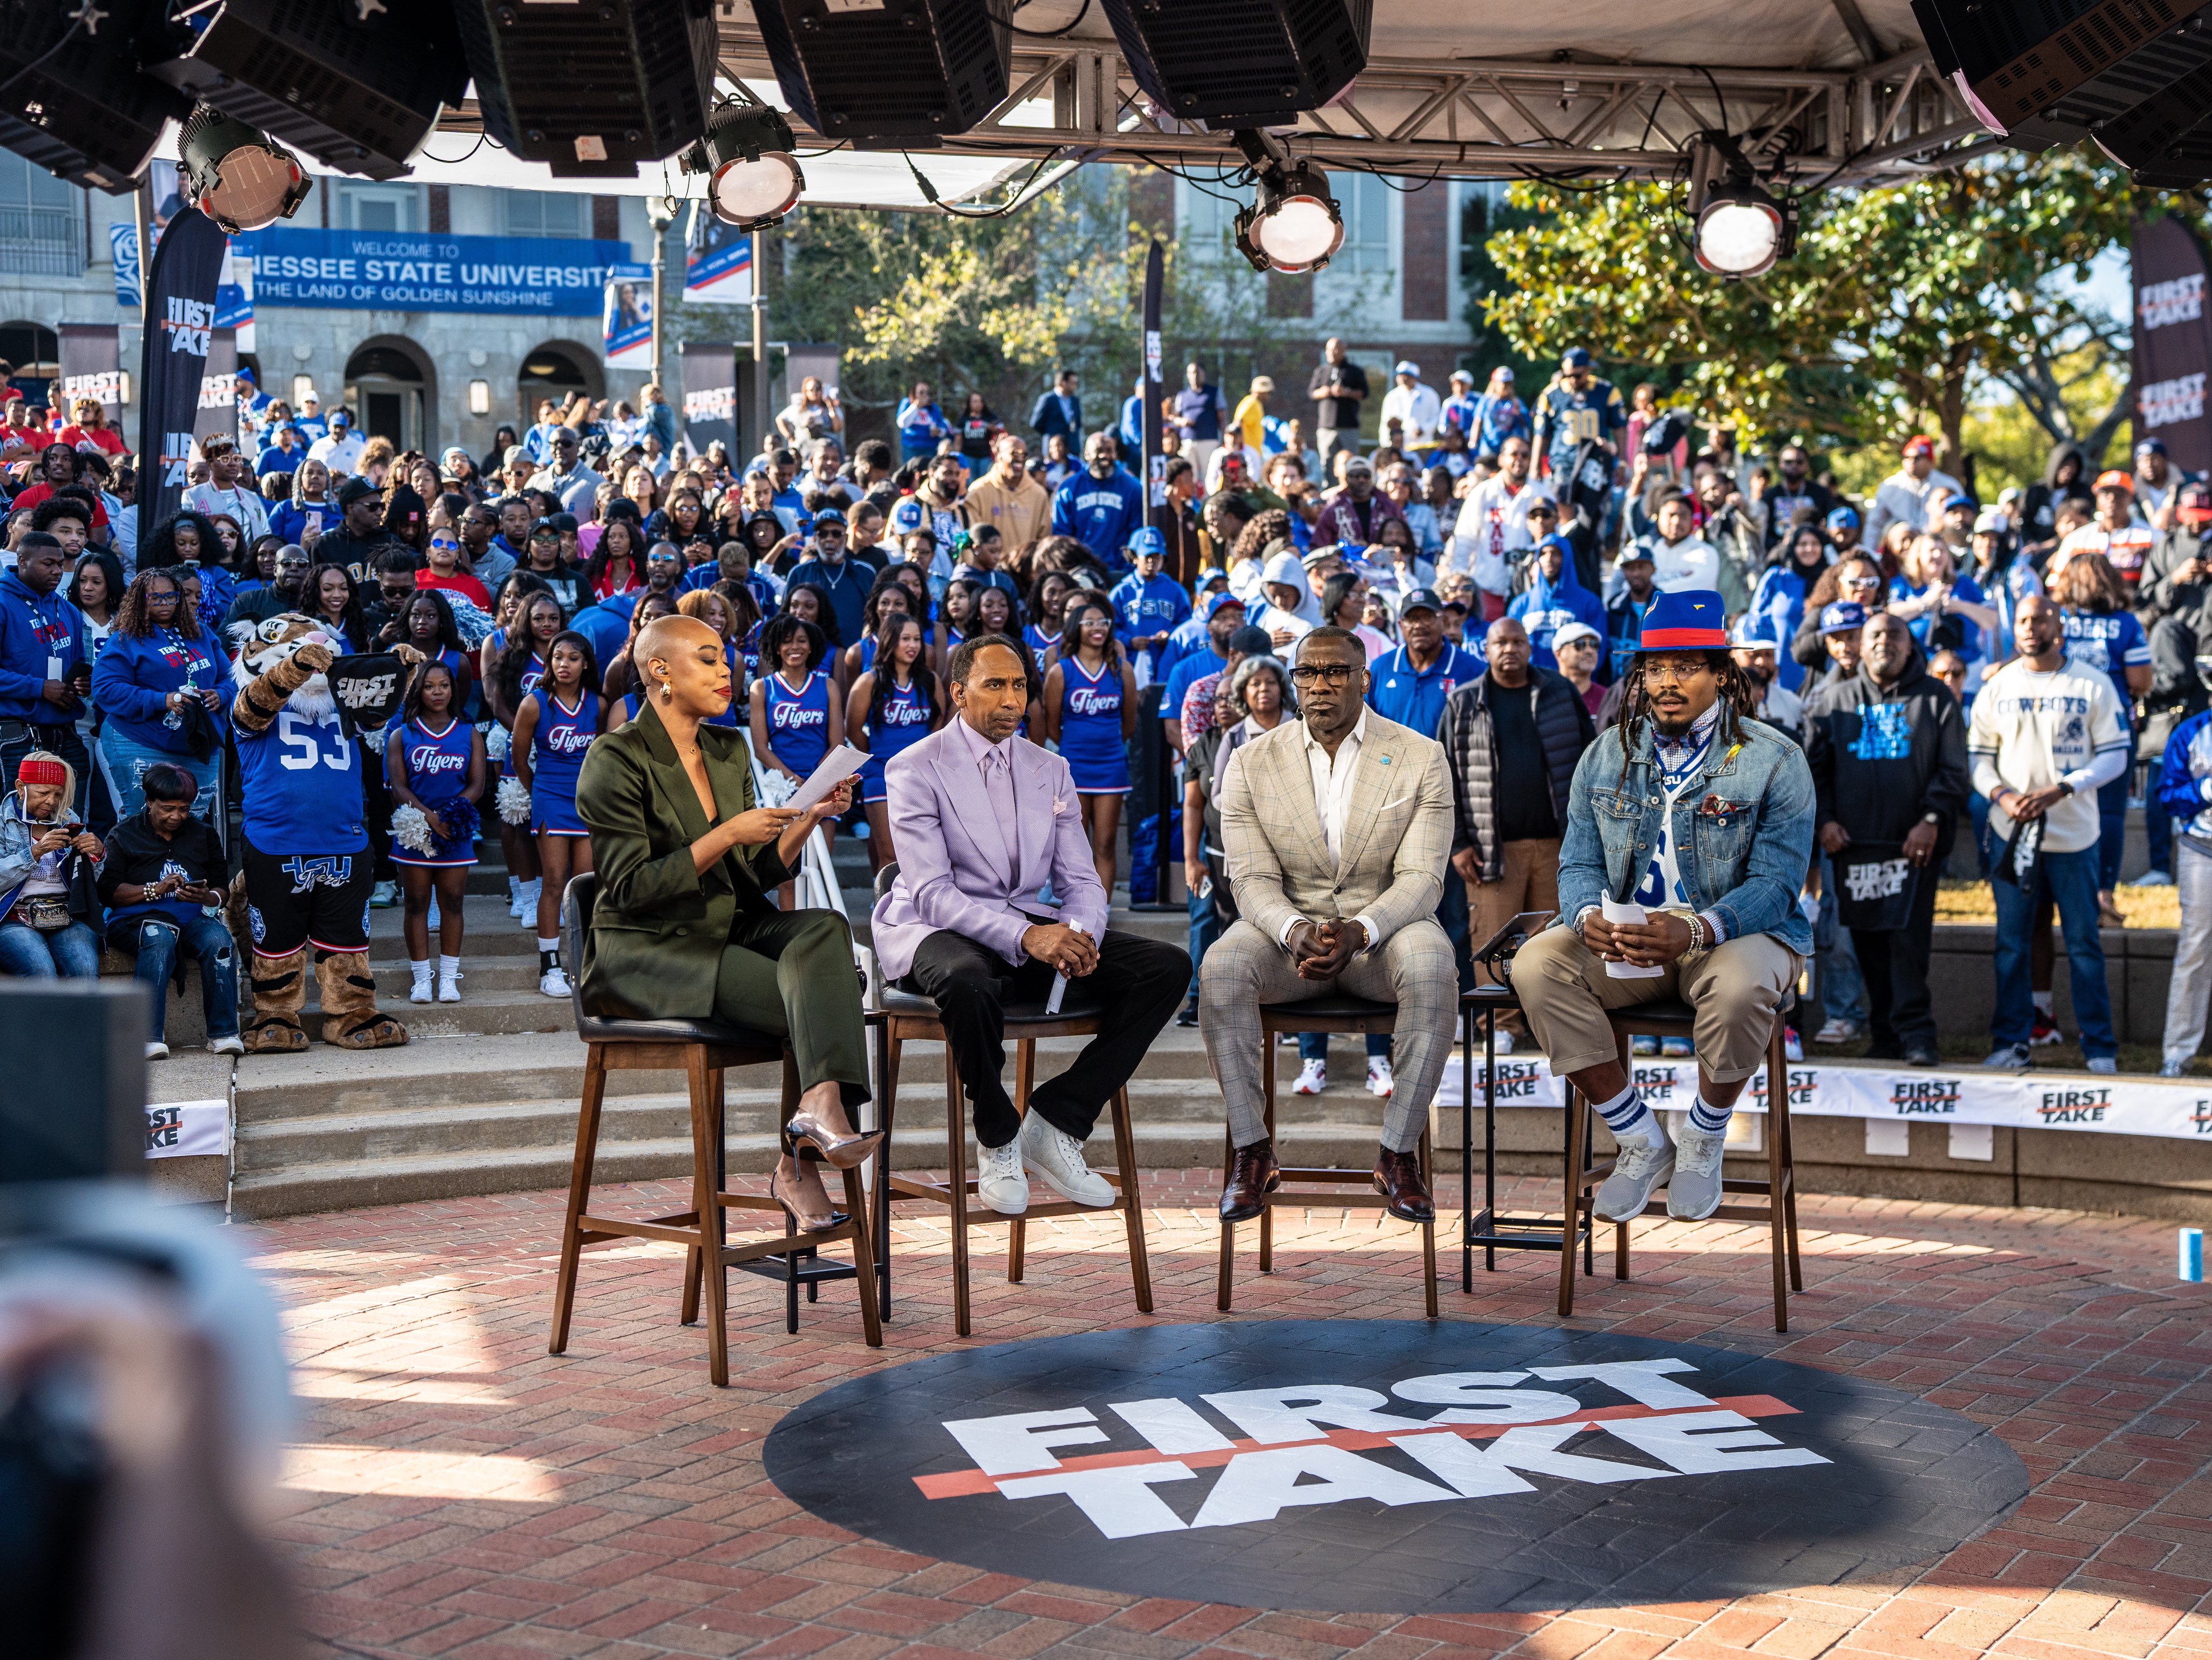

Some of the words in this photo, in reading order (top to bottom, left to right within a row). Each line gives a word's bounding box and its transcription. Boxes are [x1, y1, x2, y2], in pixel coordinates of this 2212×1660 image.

[352, 240, 431, 258] WELCOME
[438, 244, 460, 259] TO
[365, 259, 453, 284] STATE
[461, 264, 605, 288] UNIVERSIT
[255, 281, 293, 298] THE
[298, 283, 347, 300] LAND
[351, 285, 377, 300] OF
[381, 286, 458, 303] GOLDEN
[462, 289, 555, 307] SUNSHINE
[2140, 273, 2206, 306] FIRST
[2143, 300, 2202, 330] TAKE
[65, 371, 119, 392] FIRST
[201, 373, 238, 393] RST
[2140, 372, 2207, 403] FIRST
[198, 390, 237, 409] AKE
[686, 387, 735, 407] FIRST
[688, 404, 733, 424] TAKE
[2144, 398, 2204, 429] TAKE
[1561, 408, 1599, 446] 30
[197, 498, 211, 512] A
[1123, 598, 1175, 622] TSU
[337, 673, 396, 694] FIRST
[884, 699, 931, 726] Tigers
[1070, 688, 1120, 715] Tigers
[1998, 697, 2087, 714] COWBOYS
[774, 703, 824, 728] Tigers
[278, 712, 350, 771] 53
[549, 725, 597, 753] Tigers
[411, 745, 464, 774] Tigers
[1847, 858, 1910, 882] FIRST
[1846, 875, 1903, 901] TAKE
[1478, 1062, 1539, 1083] FRST
[1634, 1067, 1676, 1084] RST
[1754, 1071, 1818, 1091] FST
[1754, 1088, 1811, 1107] TKE
[1894, 1081, 1961, 1099] FIRST
[2042, 1089, 2112, 1109] FIRST
[145, 1107, 181, 1129] RST
[1896, 1098, 1955, 1114] TAKE
[2044, 1105, 2105, 1123] TAKE
[146, 1126, 178, 1151] KE
[941, 1357, 1718, 1477] FIRST
[993, 1409, 1832, 1540] TAKE
